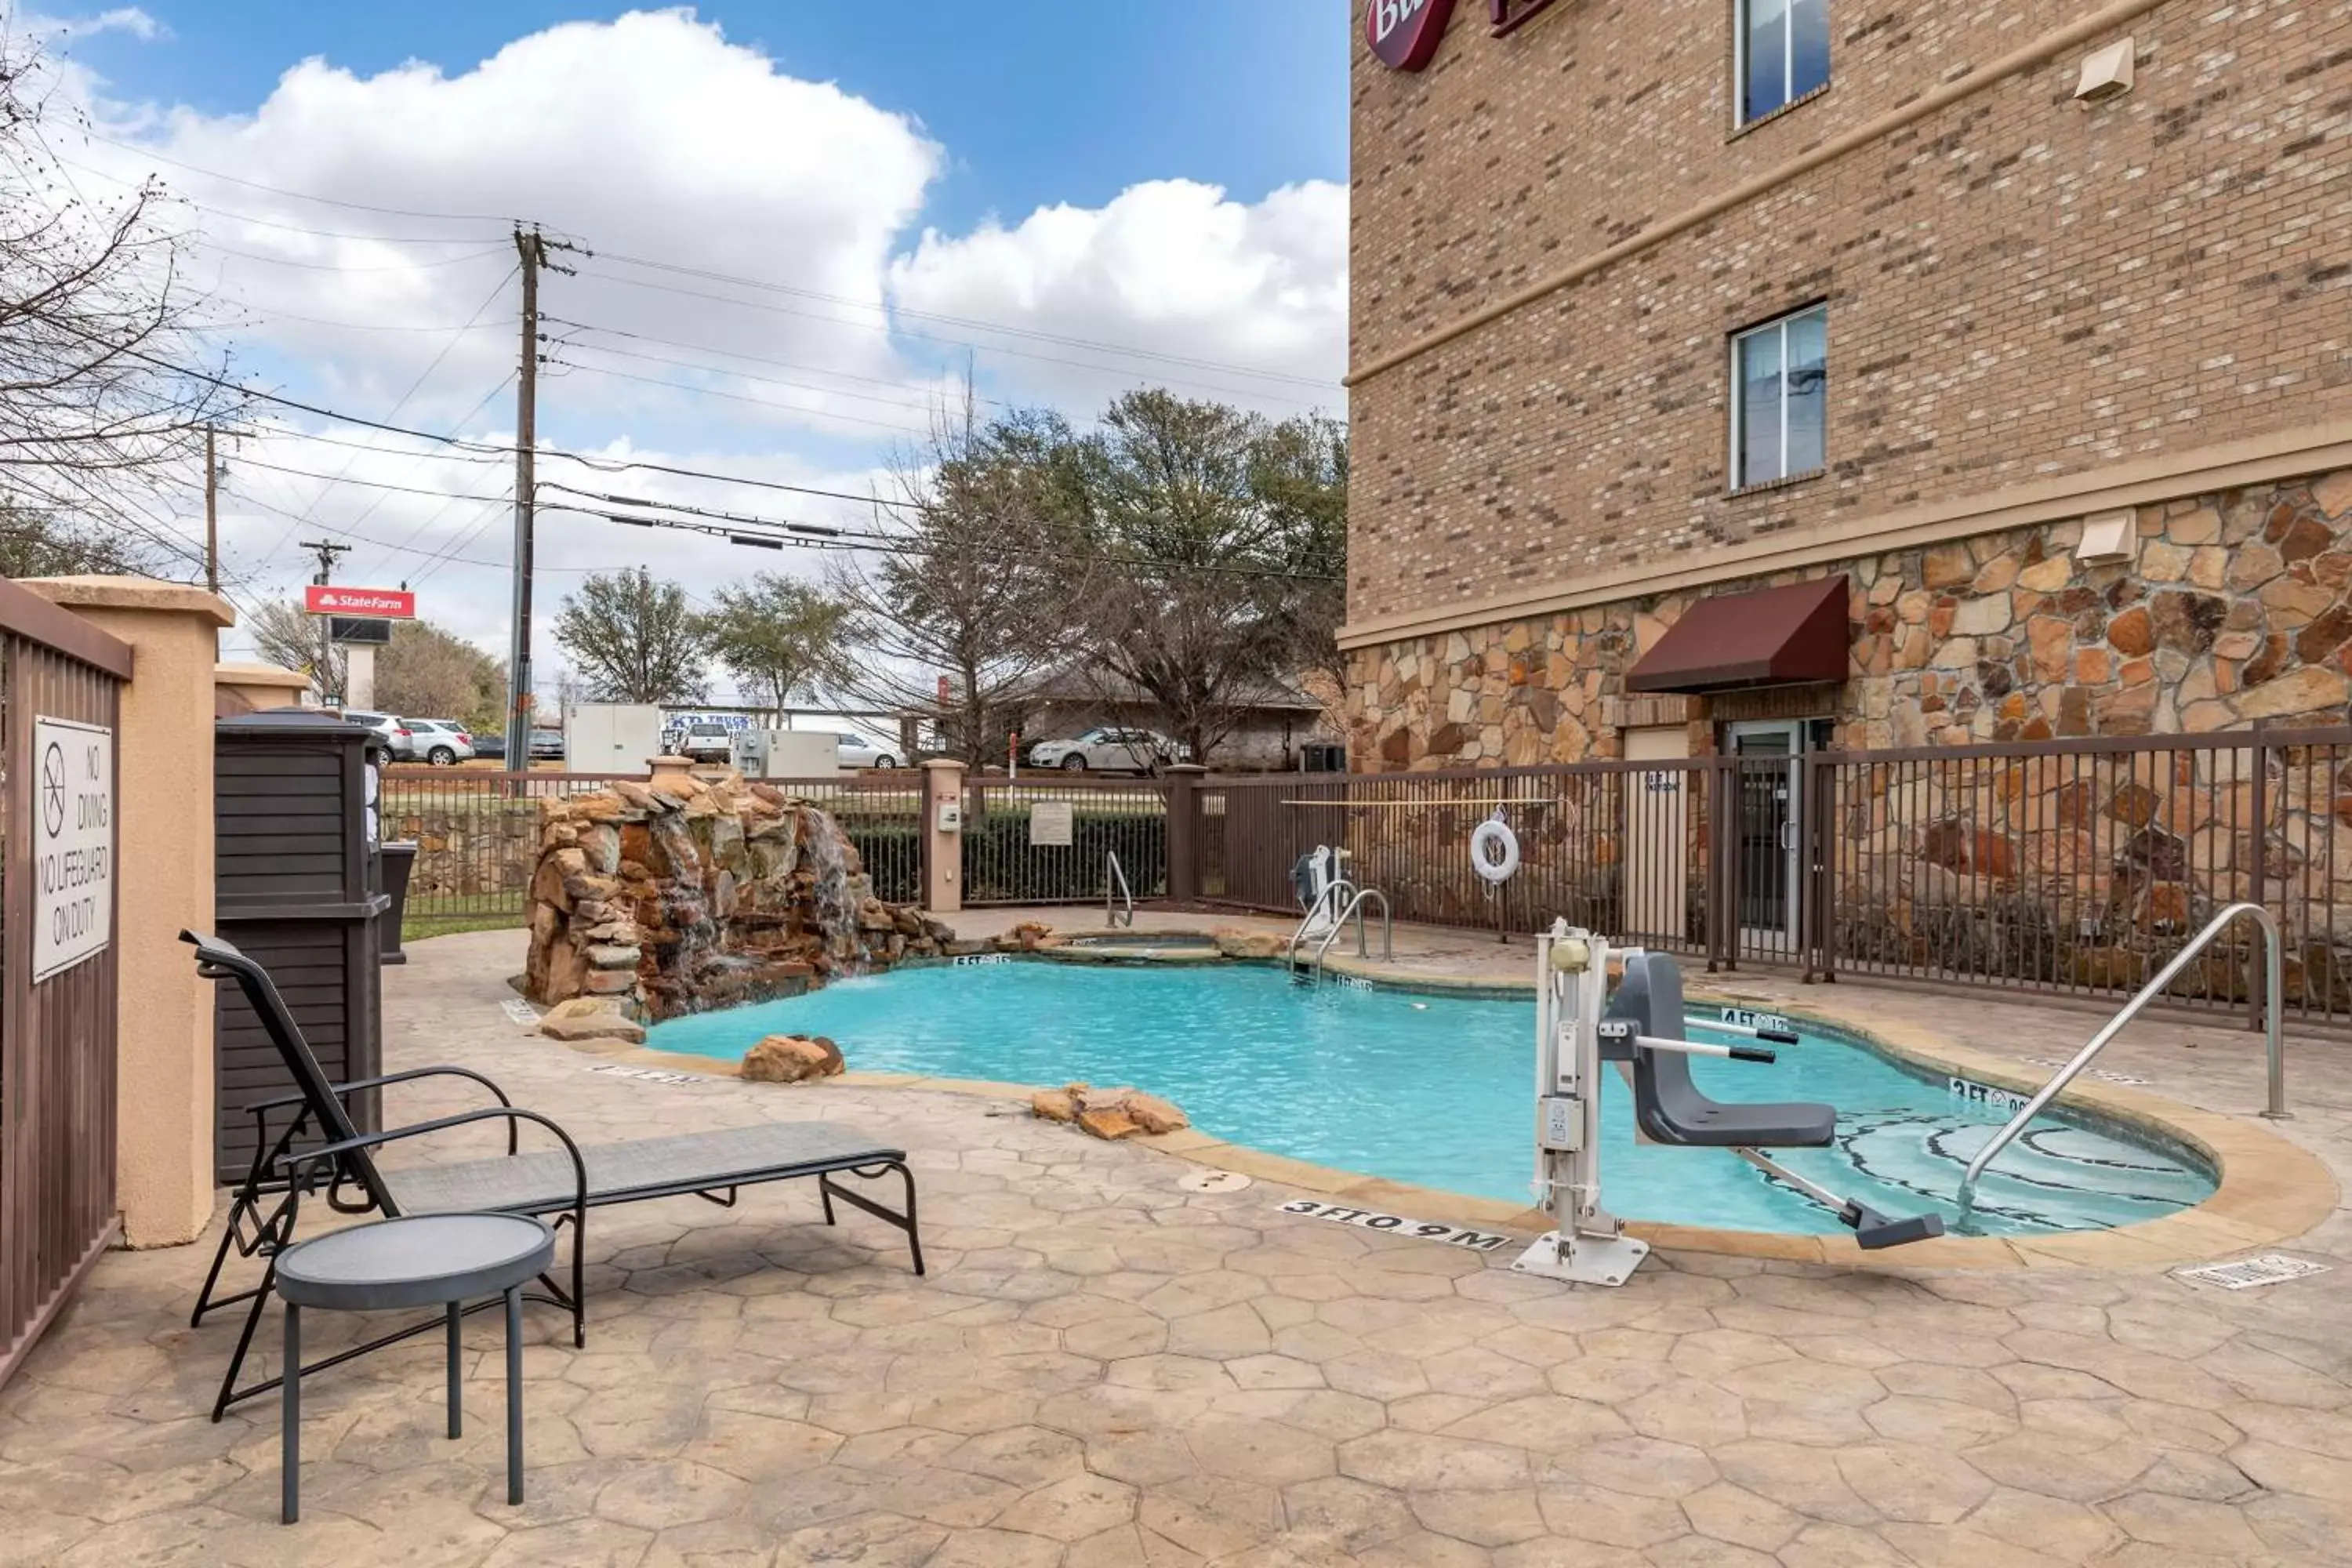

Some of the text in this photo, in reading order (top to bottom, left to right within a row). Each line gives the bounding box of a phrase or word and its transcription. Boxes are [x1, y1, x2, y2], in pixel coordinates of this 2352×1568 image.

[87, 746, 100, 781] NO
[78, 793, 107, 830] DIVING
[41, 846, 107, 895] NO LIFEGUARD
[53, 895, 96, 946] ON DUTY
[1740, 1011, 1755, 1026] FT
[1953, 1080, 1965, 1097] 3
[1969, 1084, 1987, 1102] FT
[1283, 1201, 1321, 1214] 3
[1451, 1231, 1505, 1249] M
